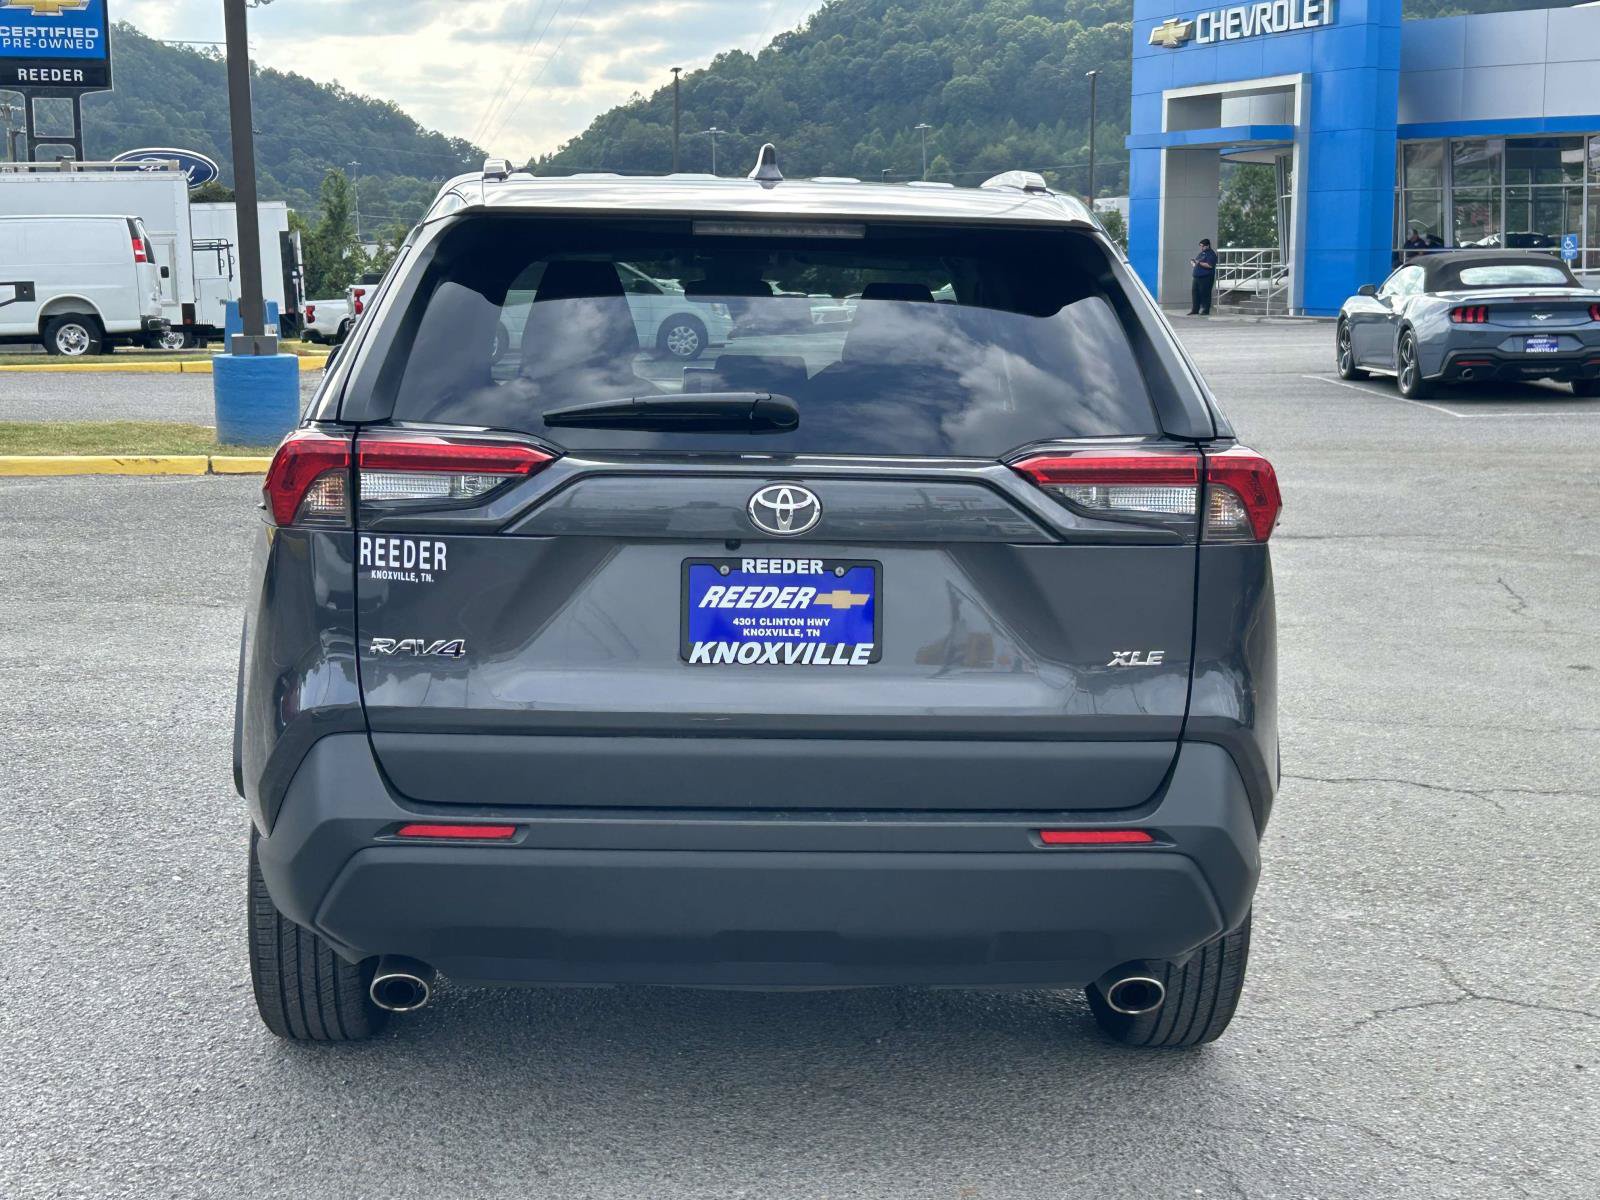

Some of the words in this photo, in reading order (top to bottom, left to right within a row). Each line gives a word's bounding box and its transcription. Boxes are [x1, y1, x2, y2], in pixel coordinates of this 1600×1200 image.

[1196, 0, 1333, 44] CHEVROLET
[0, 26, 99, 38] CERTIFIED
[2, 38, 95, 50] PRE-OWNED
[17, 68, 84, 82] REEDER
[360, 536, 447, 571] REEDER
[741, 558, 824, 575] REEDER
[371, 570, 418, 583] KNOXVILLE,
[420, 573, 434, 583] TN.
[698, 585, 816, 609] REEDER
[732, 617, 756, 627] 4301
[759, 617, 805, 627] CLINTON
[807, 617, 831, 627] HWY
[743, 628, 804, 638] KNOXVILLE,
[807, 628, 821, 637] TN
[369, 637, 467, 659] RAV4
[688, 640, 875, 666] KNOXVILLE
[1106, 650, 1165, 667] XLE
